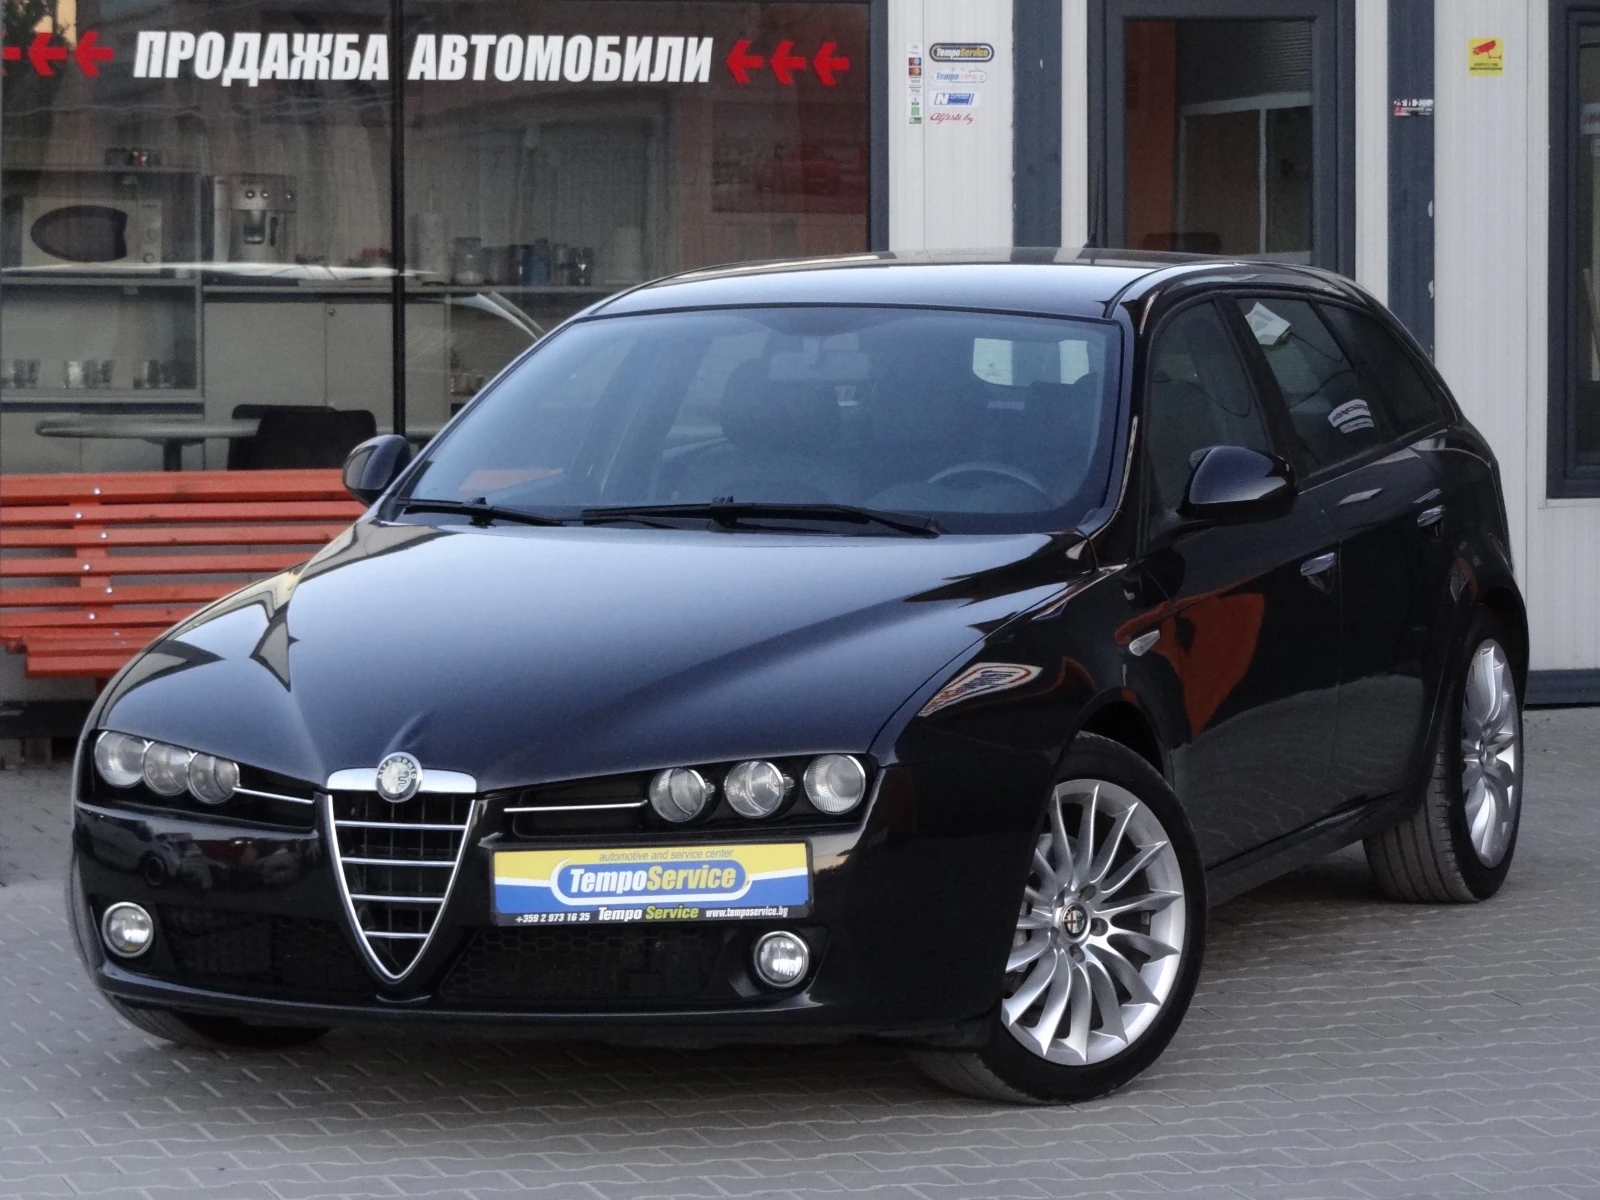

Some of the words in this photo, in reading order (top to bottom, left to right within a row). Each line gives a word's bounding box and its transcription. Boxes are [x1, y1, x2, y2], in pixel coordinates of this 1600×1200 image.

[133, 30, 389, 87] ПРОДАЖБА
[406, 33, 714, 83] АВТОМОБИЛИ
[936, 48, 988, 60] TempoService
[599, 851, 649, 862] automotive
[651, 850, 668, 860] and
[670, 849, 703, 859] service
[705, 849, 734, 858] center
[570, 864, 736, 893] TempoService
[515, 914, 539, 923] +359
[540, 914, 547, 922] 2
[548, 914, 564, 922] 973
[566, 913, 578, 922] 16
[579, 913, 590, 921] 35
[598, 907, 643, 922] Tempo
[645, 905, 699, 919] Service
[705, 906, 789, 919] www.temposervice.bg
